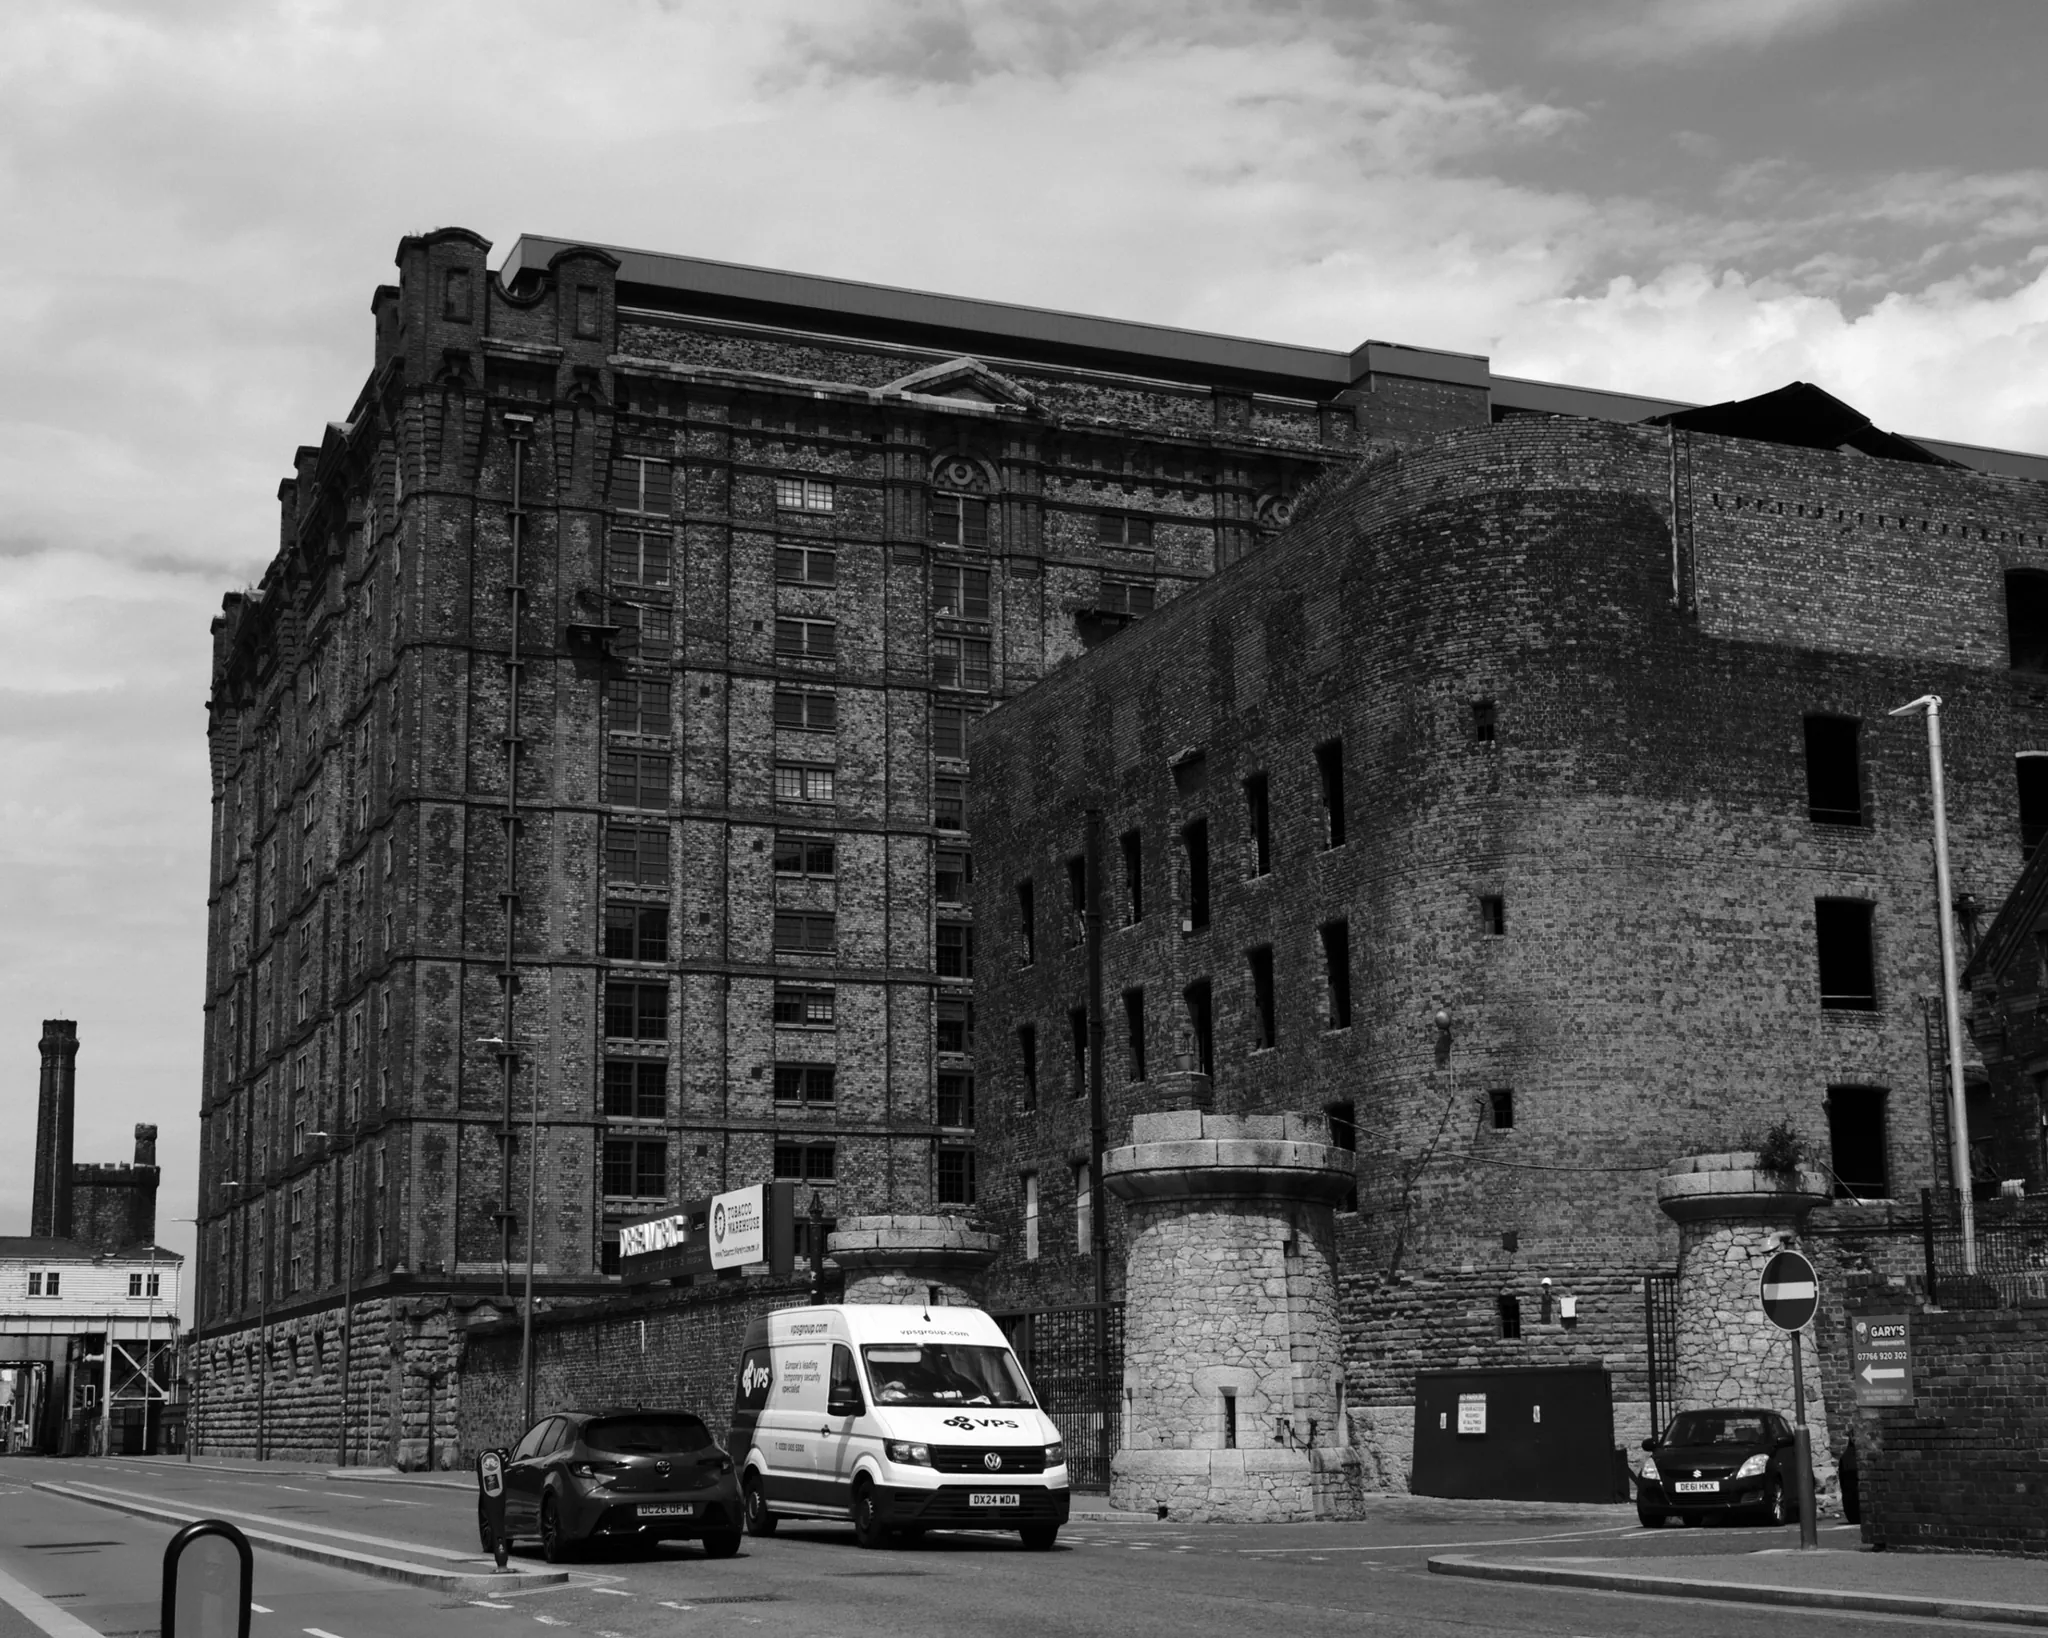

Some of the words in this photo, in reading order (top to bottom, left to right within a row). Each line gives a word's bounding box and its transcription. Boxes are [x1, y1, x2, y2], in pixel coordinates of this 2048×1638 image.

[727, 1202, 752, 1219] TOBACCO
[728, 1216, 760, 1233] WAREHOUSE
[790, 1324, 828, 1335] vpsgroup.com
[900, 1329, 970, 1337] vpsgroup.com
[1871, 1325, 1905, 1337] GARY'S
[1879, 1352, 1893, 1360] 920
[1894, 1351, 1907, 1360] 302
[754, 1367, 770, 1388] VPS
[974, 1419, 1019, 1429] VPS
[1680, 1483, 1697, 1491] DE61
[974, 1495, 997, 1504] DX24
